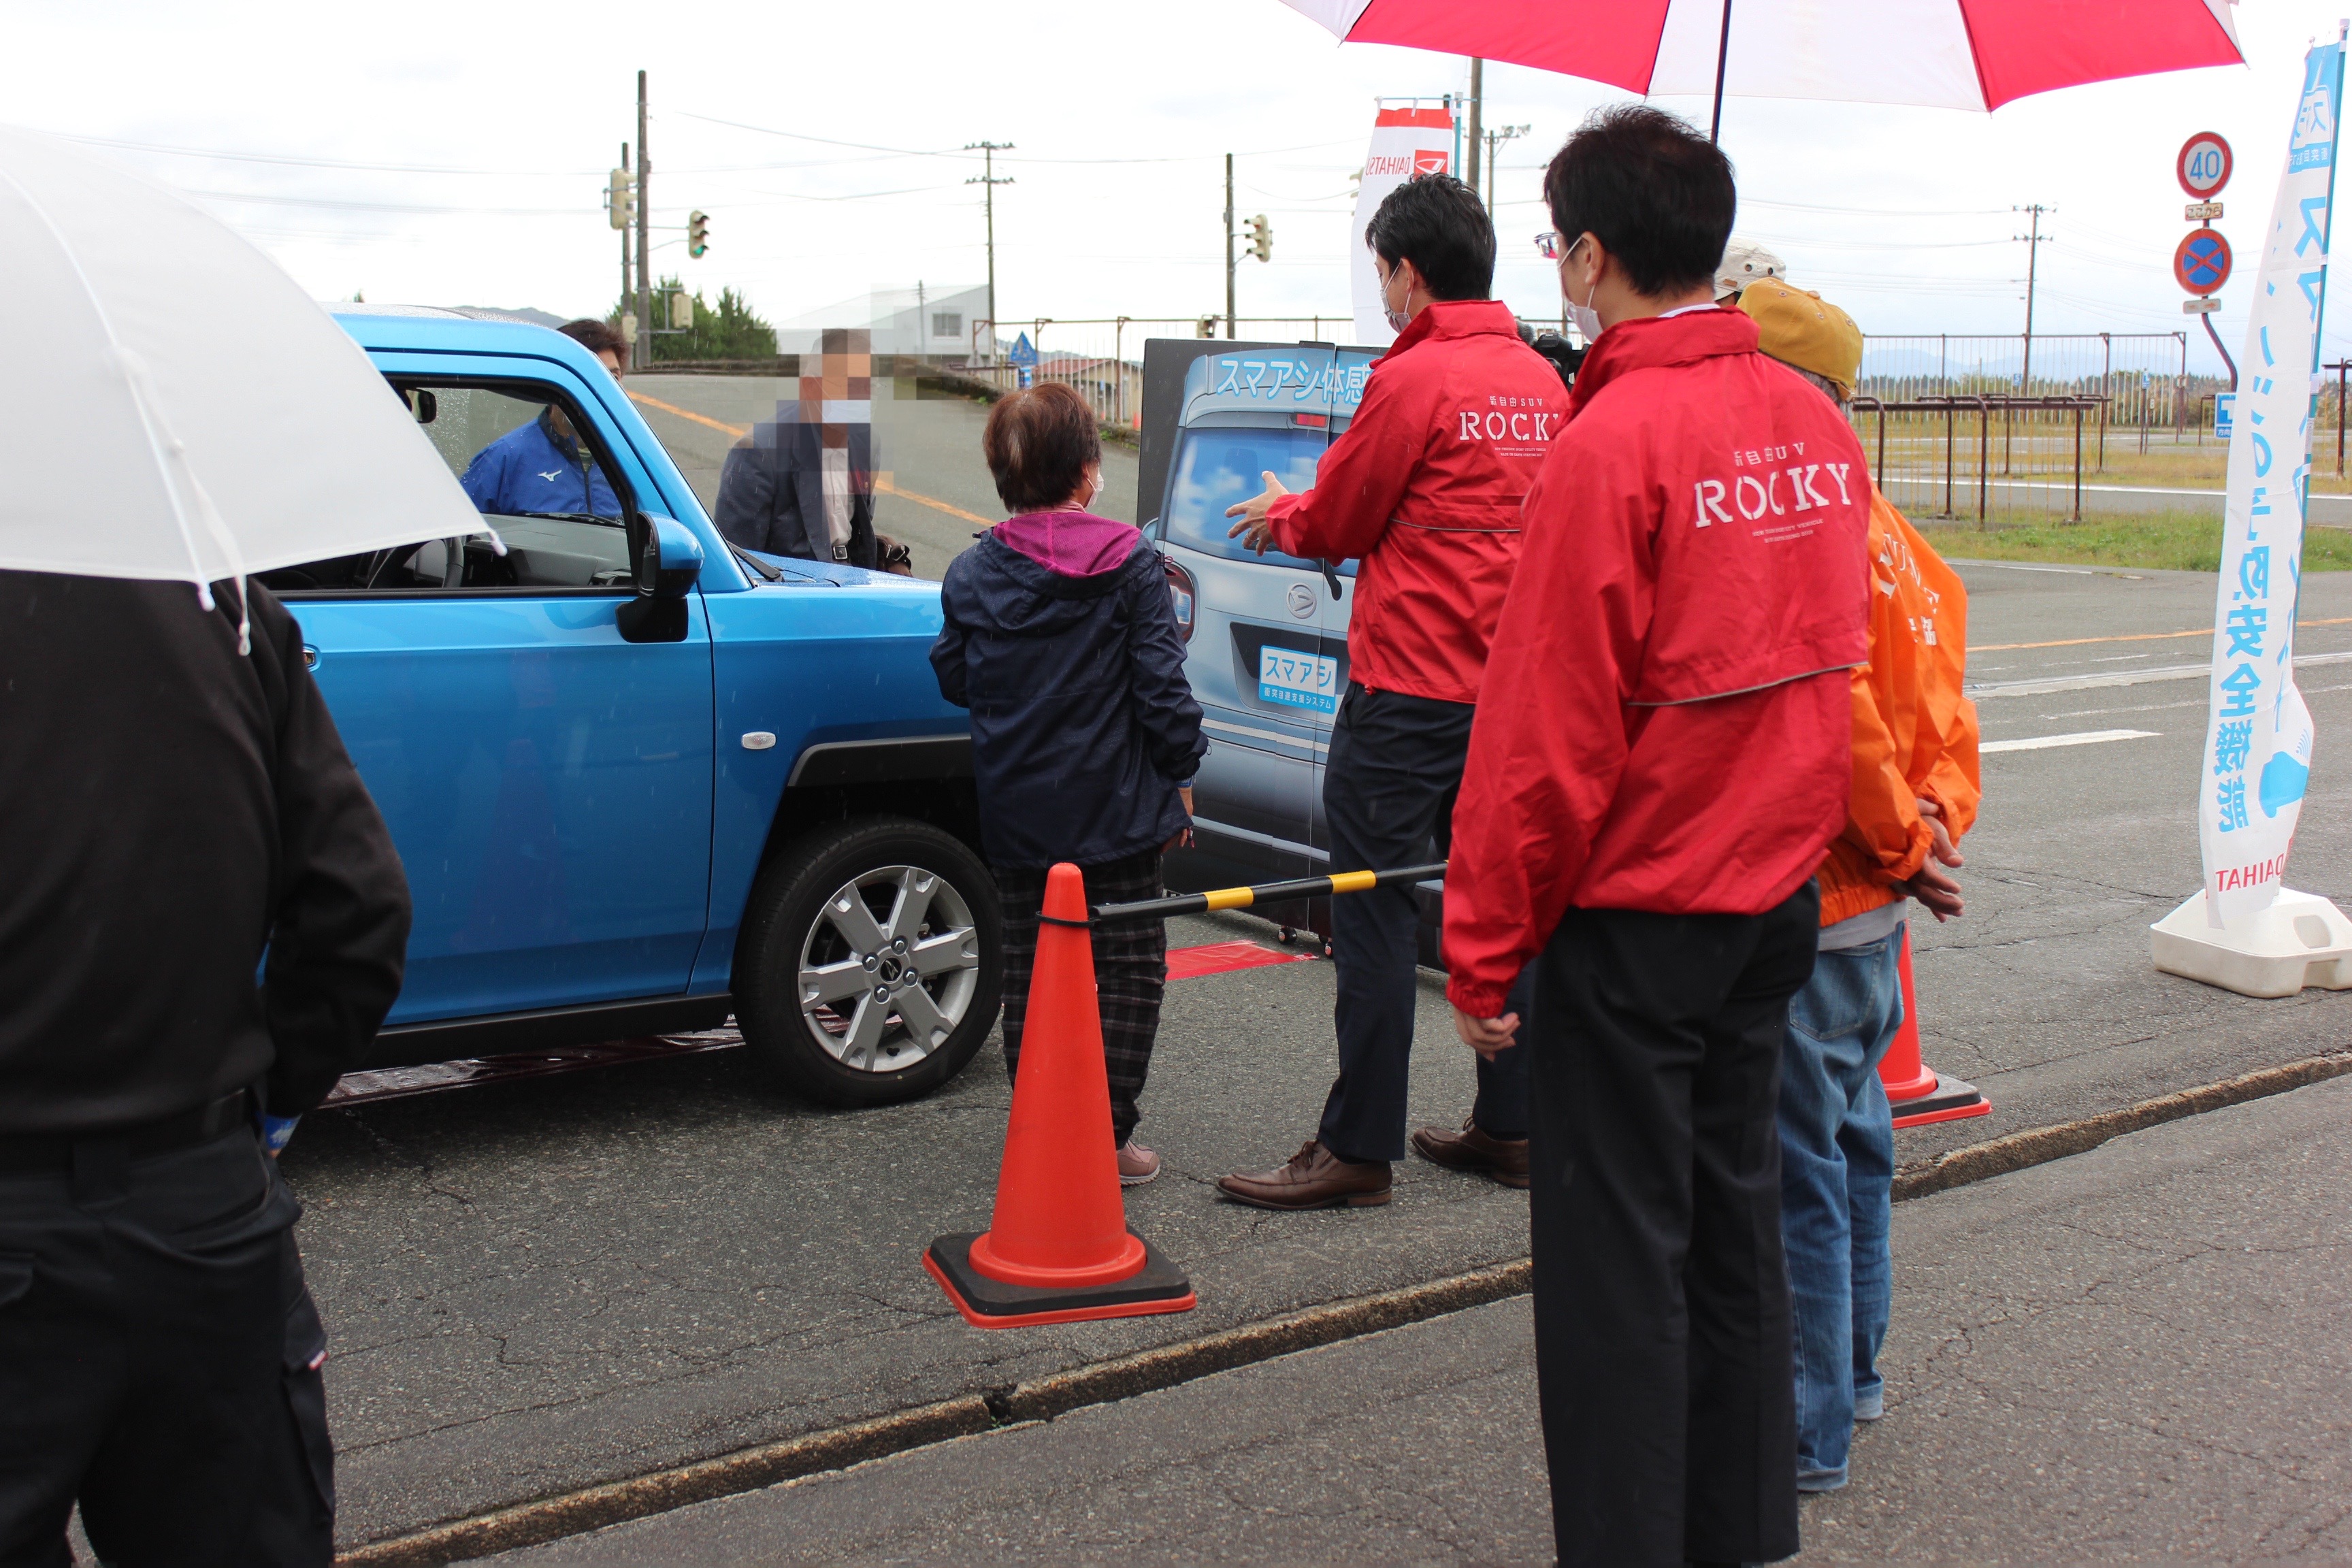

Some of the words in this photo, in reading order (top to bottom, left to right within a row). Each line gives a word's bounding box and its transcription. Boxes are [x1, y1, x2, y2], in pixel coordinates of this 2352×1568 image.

[2189, 150, 2220, 180] 40
[2187, 206, 2222, 218] ここから
[1217, 359, 1371, 404] スマアシ体感
[1459, 411, 1558, 441] ROCK
[1694, 463, 1852, 528] ROCKY
[1266, 656, 1331, 687] スマアシ
[1264, 687, 1331, 709] 衝突回避支援システム
